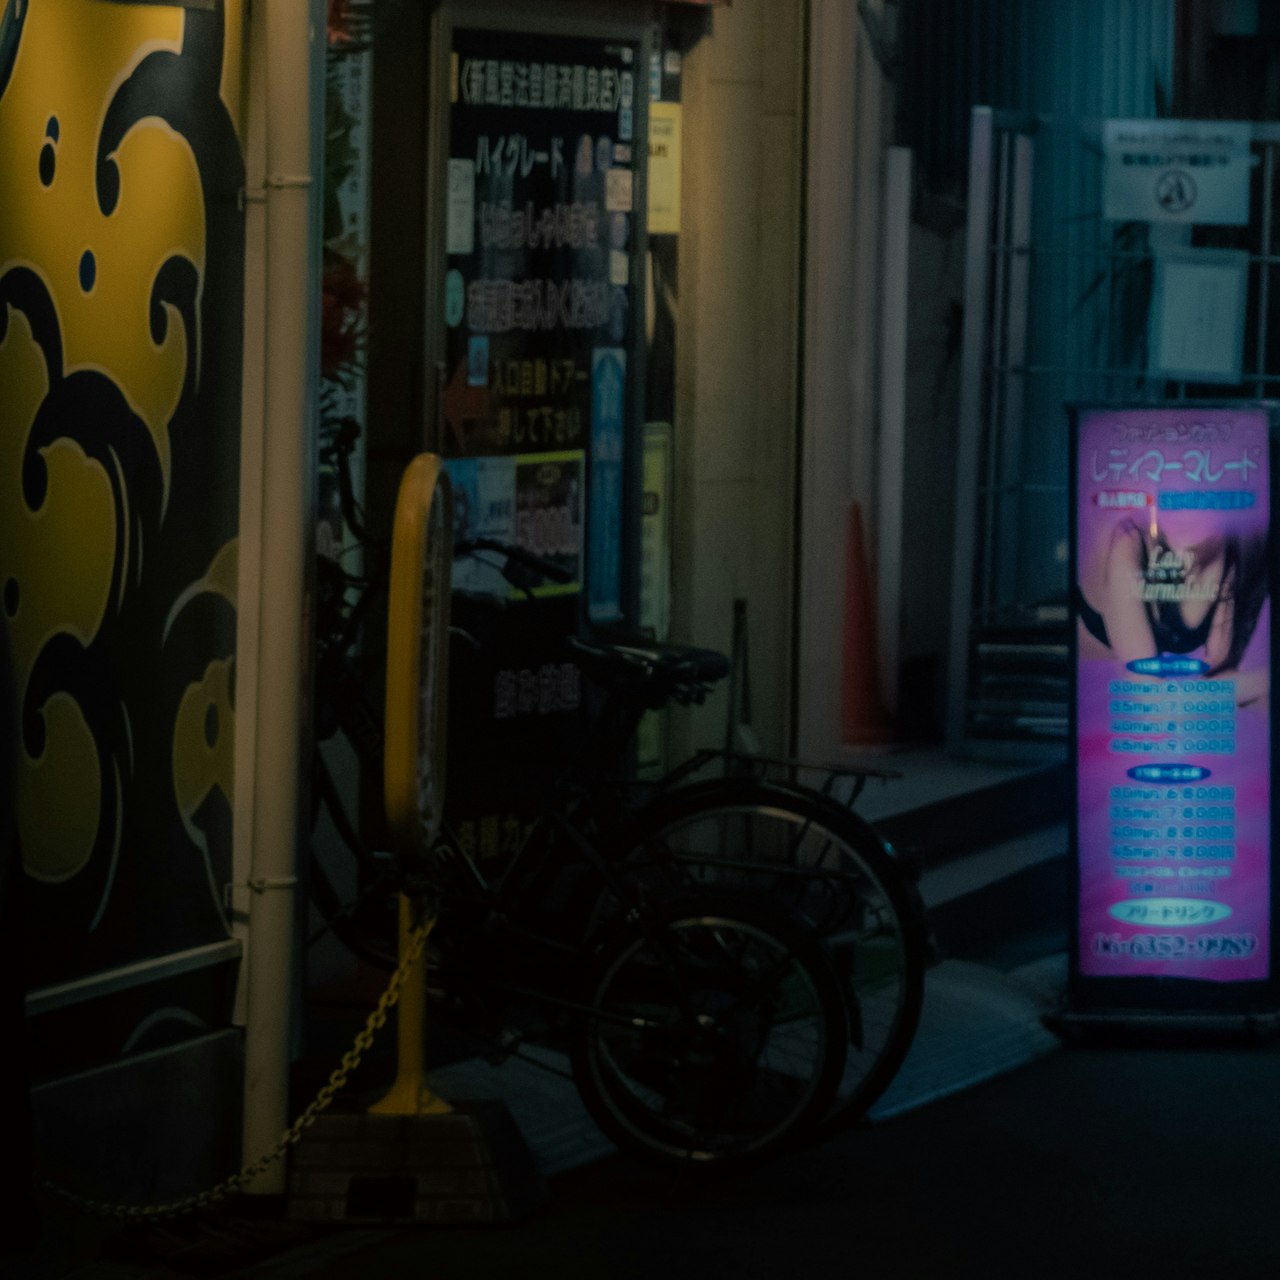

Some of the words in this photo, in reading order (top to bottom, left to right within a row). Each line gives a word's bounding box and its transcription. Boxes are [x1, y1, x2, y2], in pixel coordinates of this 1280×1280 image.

[475, 133, 565, 179] ハイグレード
[1130, 903, 1215, 921] フリードリンク
